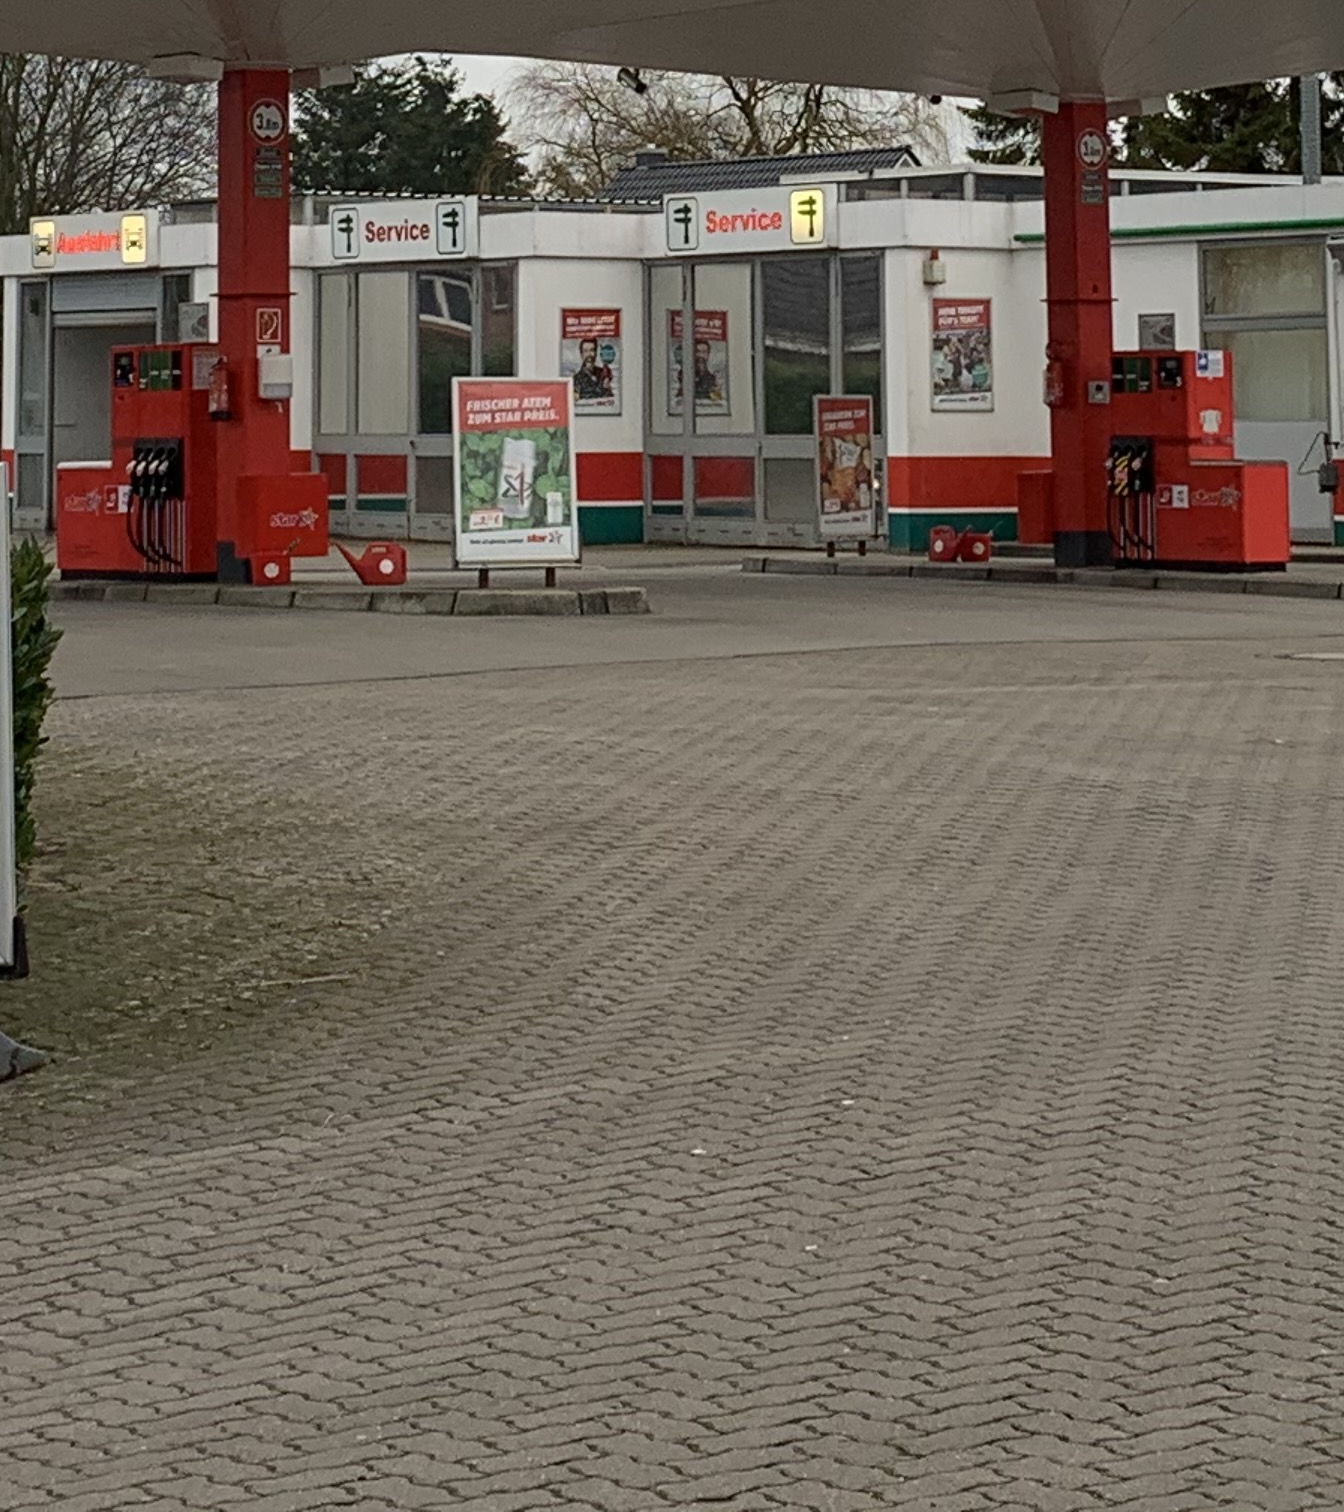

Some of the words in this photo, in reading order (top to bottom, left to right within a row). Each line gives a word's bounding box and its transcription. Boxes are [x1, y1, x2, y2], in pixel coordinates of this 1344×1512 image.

[706, 208, 782, 233] Service
[365, 218, 431, 243] Service
[466, 398, 520, 412] FRISCHER
[522, 396, 551, 408] ATEM
[467, 411, 493, 425] ZUM
[494, 410, 522, 423] STAR
[270, 513, 300, 527] star
